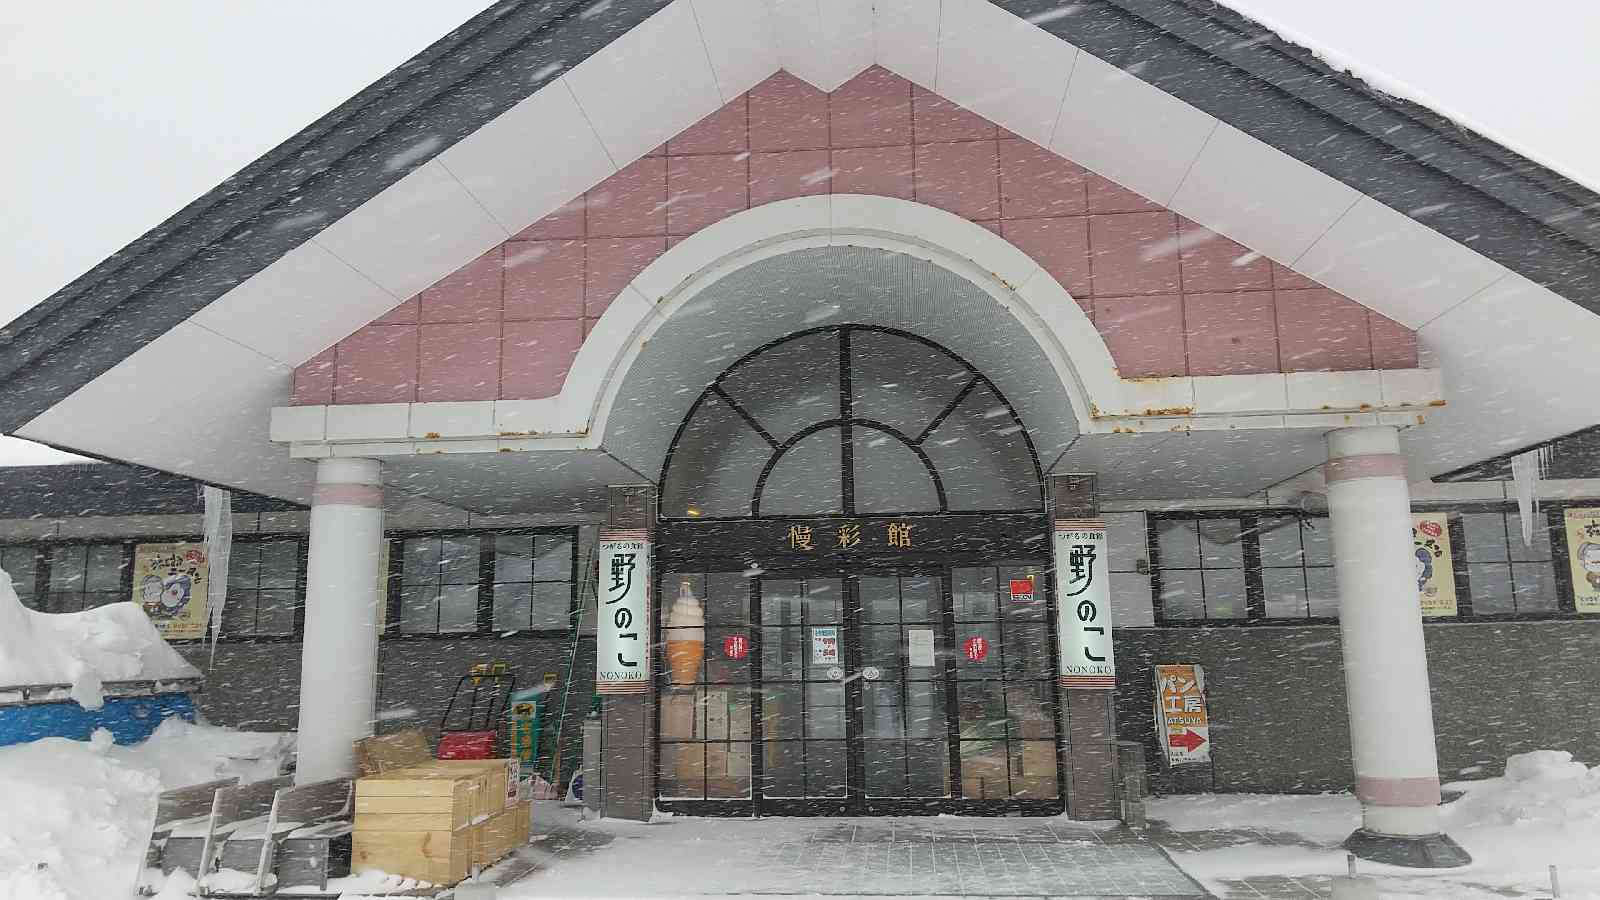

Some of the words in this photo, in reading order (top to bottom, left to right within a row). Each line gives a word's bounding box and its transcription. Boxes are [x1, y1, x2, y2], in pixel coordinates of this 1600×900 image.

[605, 553, 638, 667] 野のこ
[1066, 544, 1106, 662] 野のこ
[600, 671, 642, 680] NONOKO
[1066, 664, 1112, 674] NONOKO
[1160, 674, 1195, 692] パン
[1165, 695, 1202, 713] 工房
